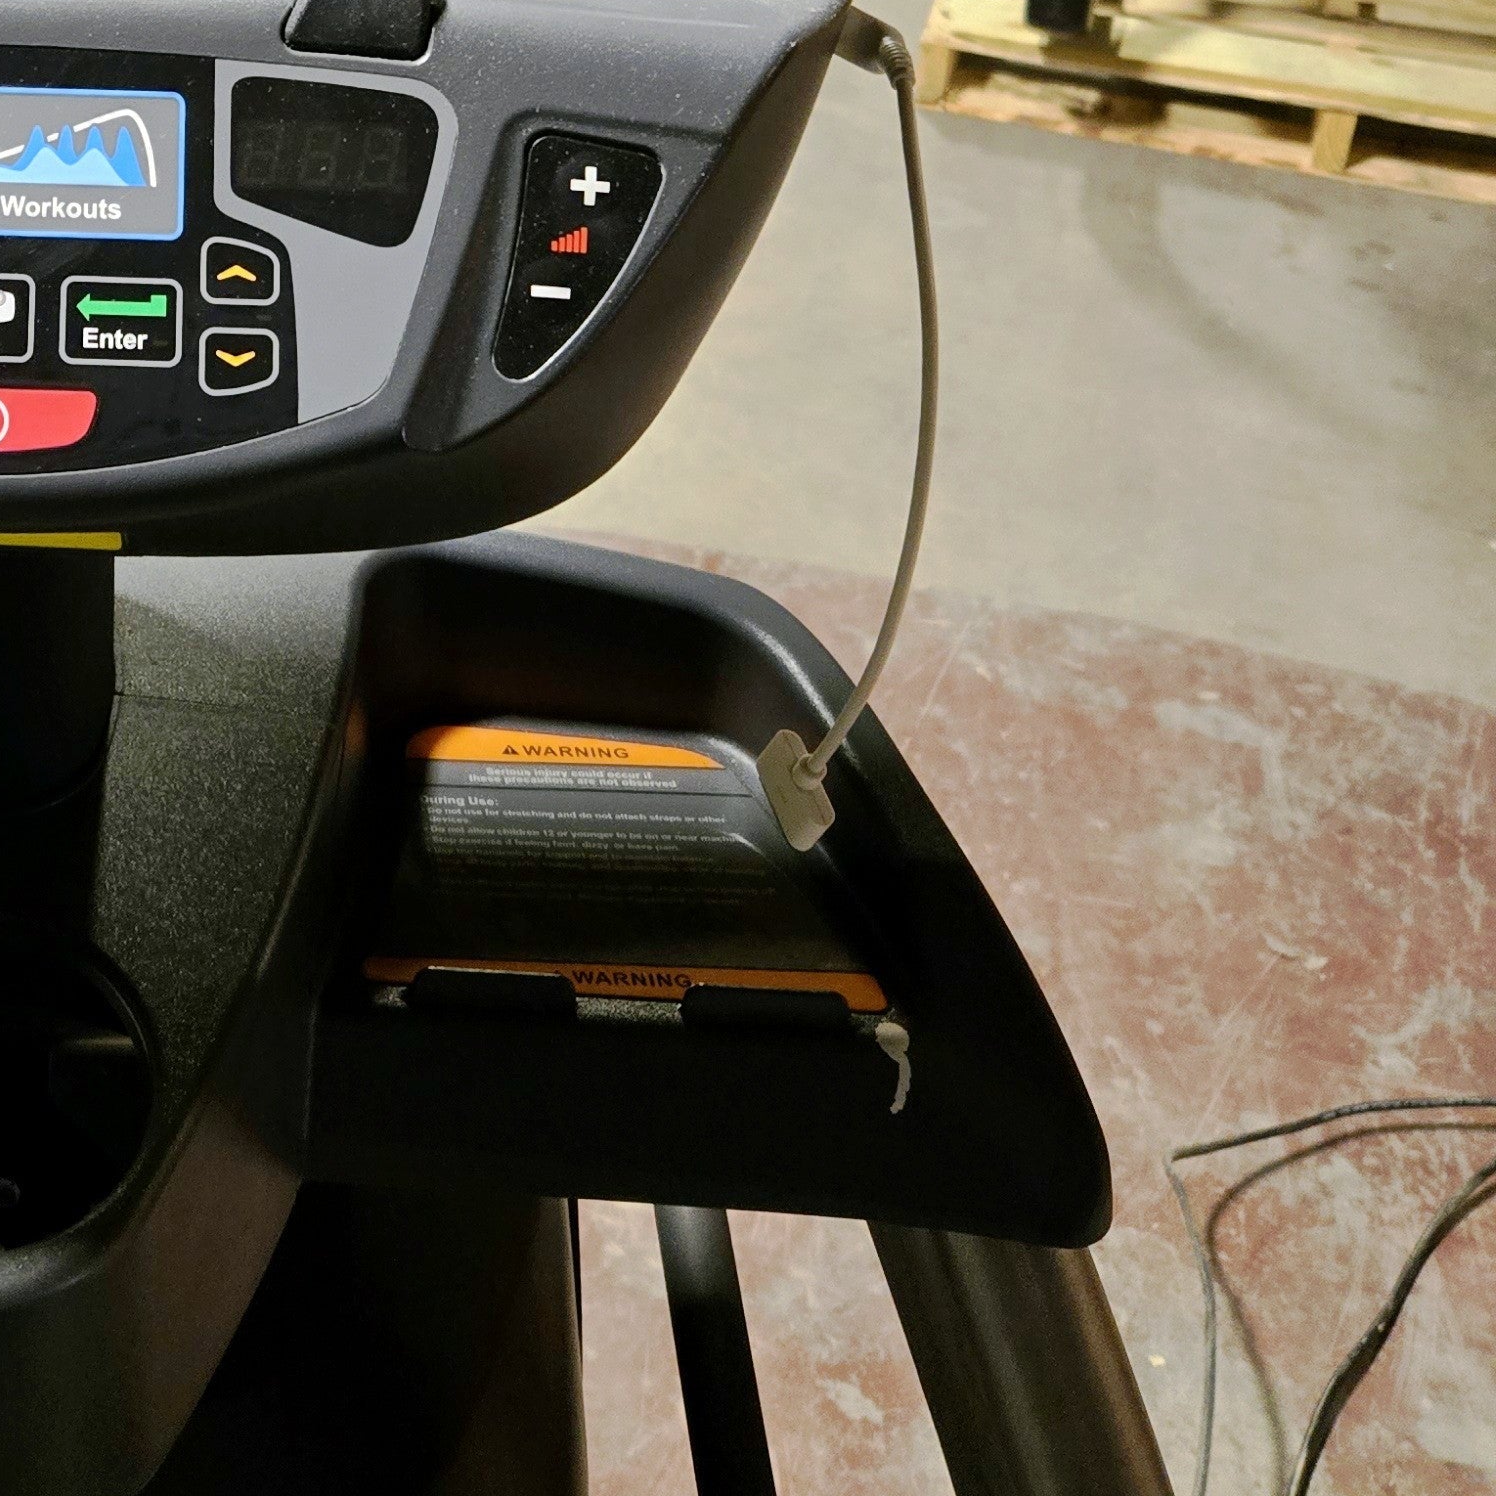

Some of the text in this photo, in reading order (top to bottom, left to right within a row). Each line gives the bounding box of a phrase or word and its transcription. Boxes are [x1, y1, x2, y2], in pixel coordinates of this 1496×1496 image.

[0, 194, 122, 220] Workouts
[82, 327, 149, 351] Enter
[522, 745, 630, 759] WARNING
[571, 969, 694, 988] WARNING
